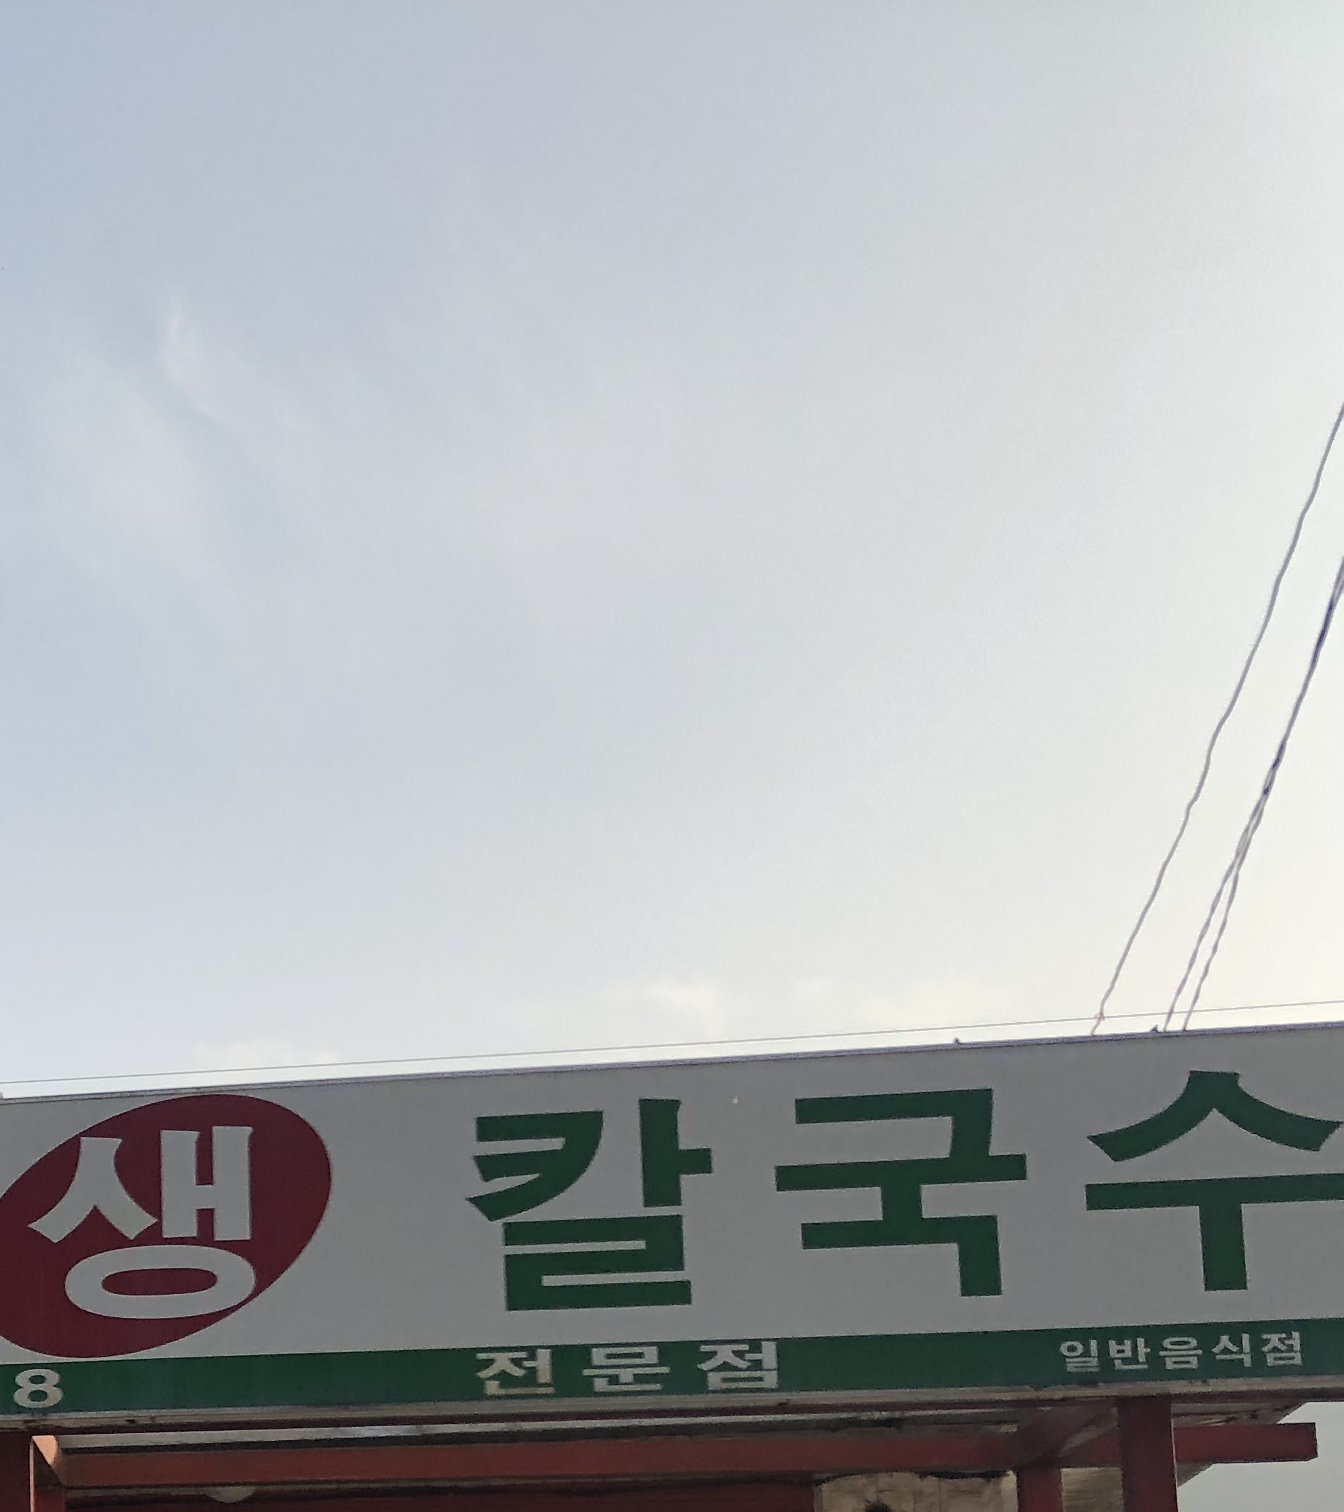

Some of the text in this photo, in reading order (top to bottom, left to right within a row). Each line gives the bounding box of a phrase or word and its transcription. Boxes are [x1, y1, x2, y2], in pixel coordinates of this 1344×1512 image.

[28, 1126, 255, 1319] 생
[464, 1069, 1344, 1310] 칼국수
[476, 1341, 779, 1394] 전문점
[1058, 1331, 1305, 1373] 일반음식점
